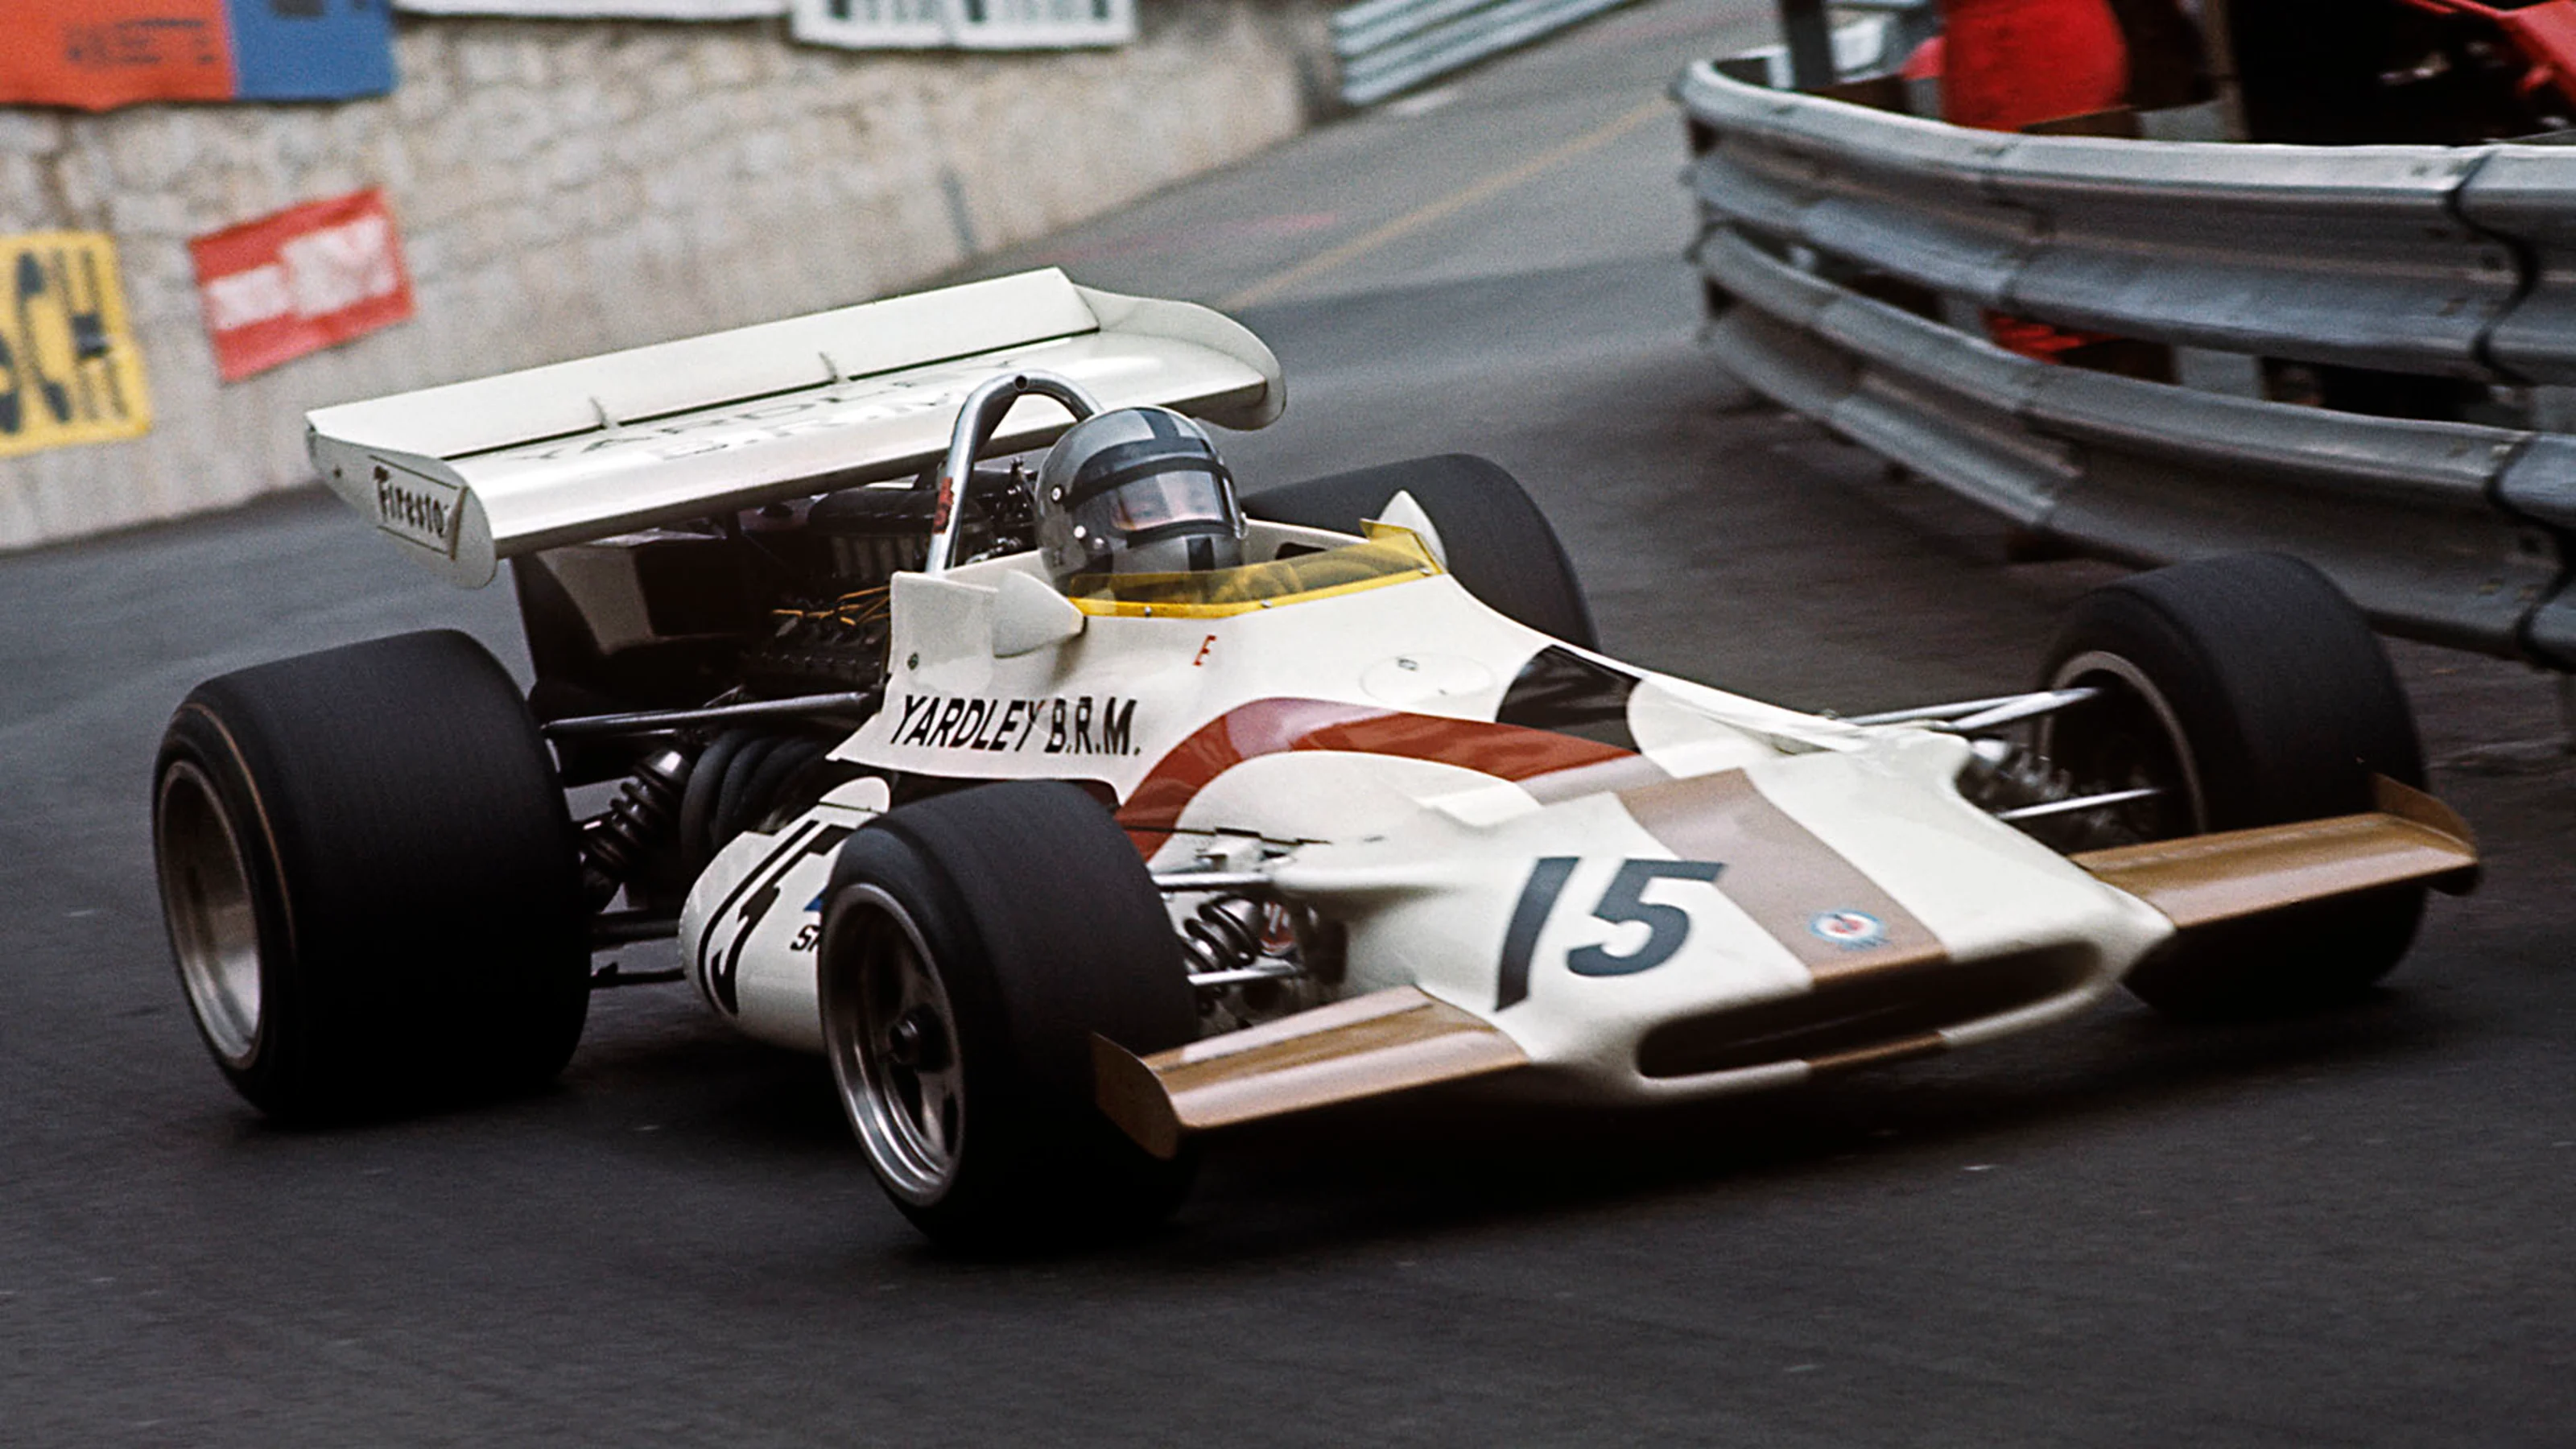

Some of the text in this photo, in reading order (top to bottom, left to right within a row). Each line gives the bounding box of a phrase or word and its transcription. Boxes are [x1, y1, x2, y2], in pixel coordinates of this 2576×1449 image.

[374, 465, 449, 539] Firesto
[890, 695, 1141, 756] YARDLEY B.R.M.
[1493, 856, 1728, 1013] 15
